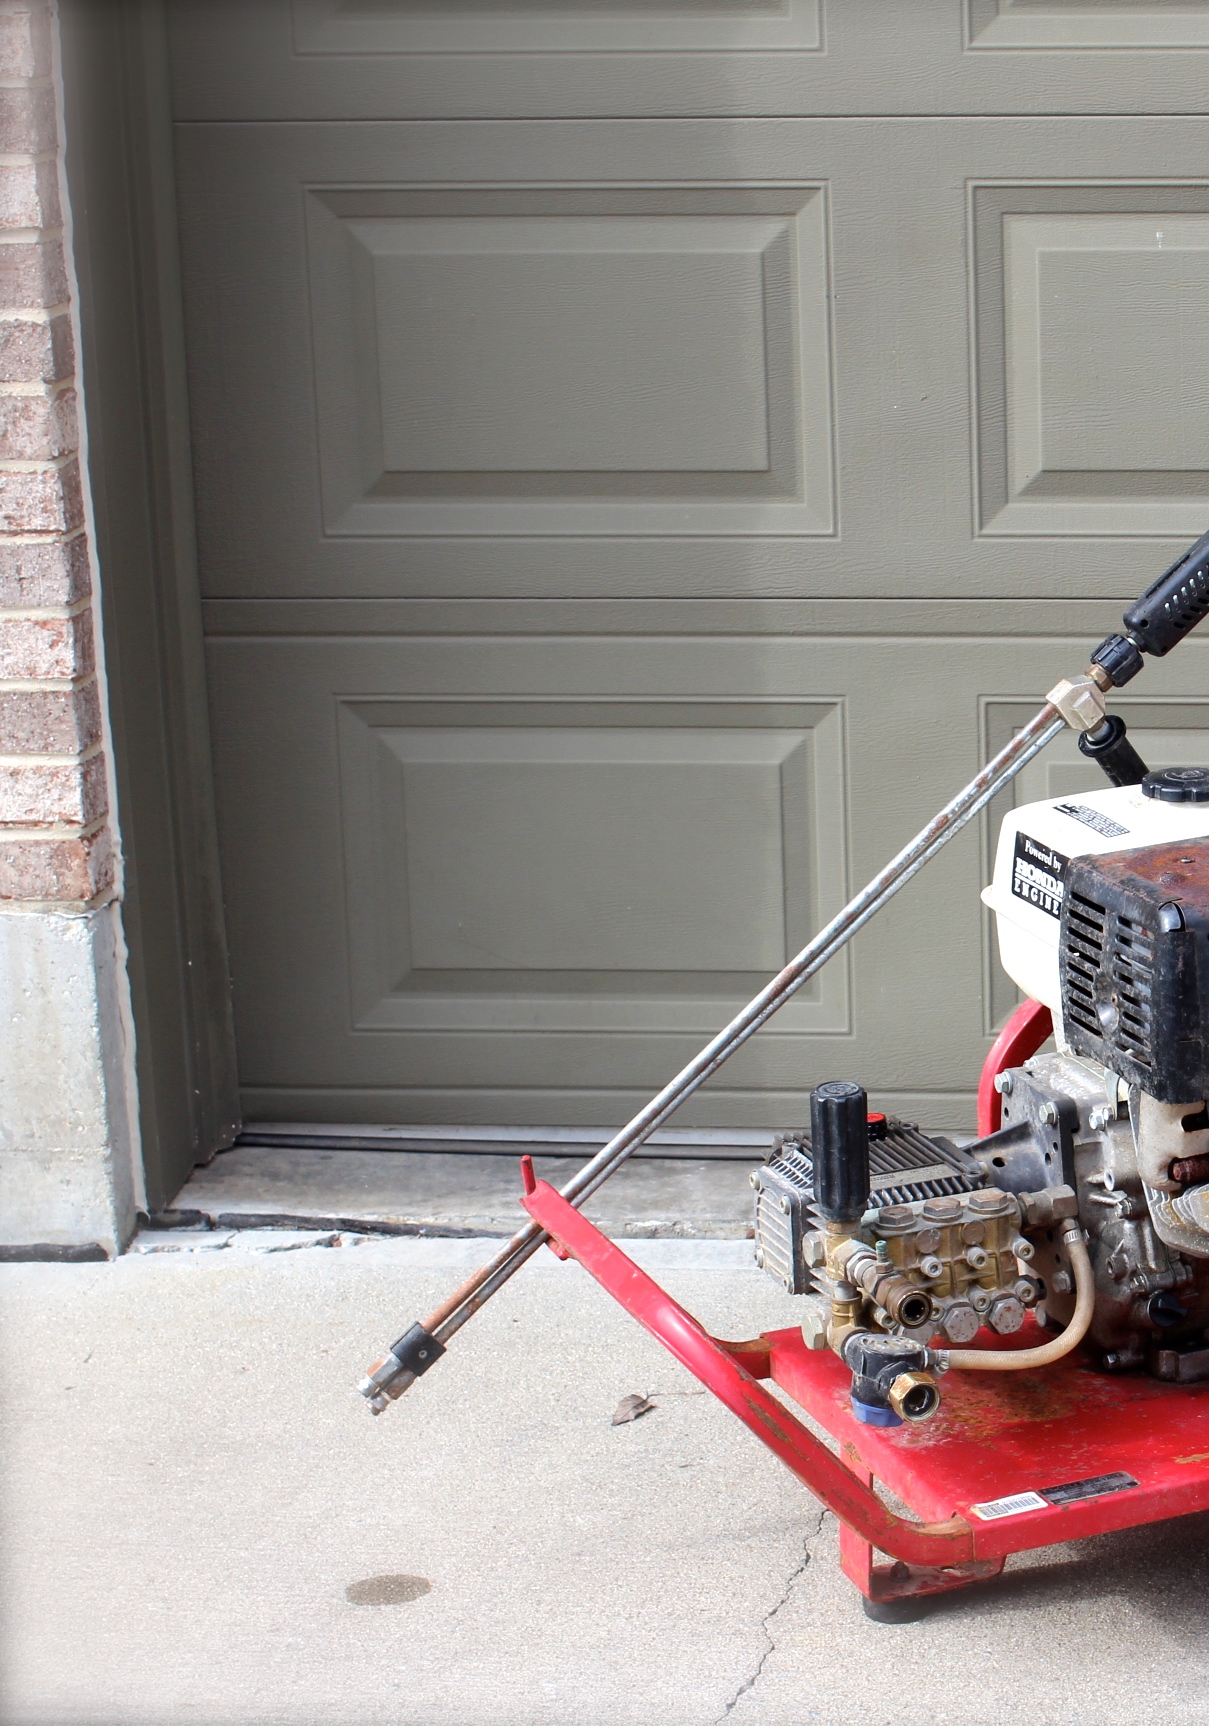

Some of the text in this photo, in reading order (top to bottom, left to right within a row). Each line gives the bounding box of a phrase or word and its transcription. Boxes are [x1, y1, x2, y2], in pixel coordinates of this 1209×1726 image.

[1024, 839, 1063, 873] Powered by
[1015, 857, 1064, 898] HONDA
